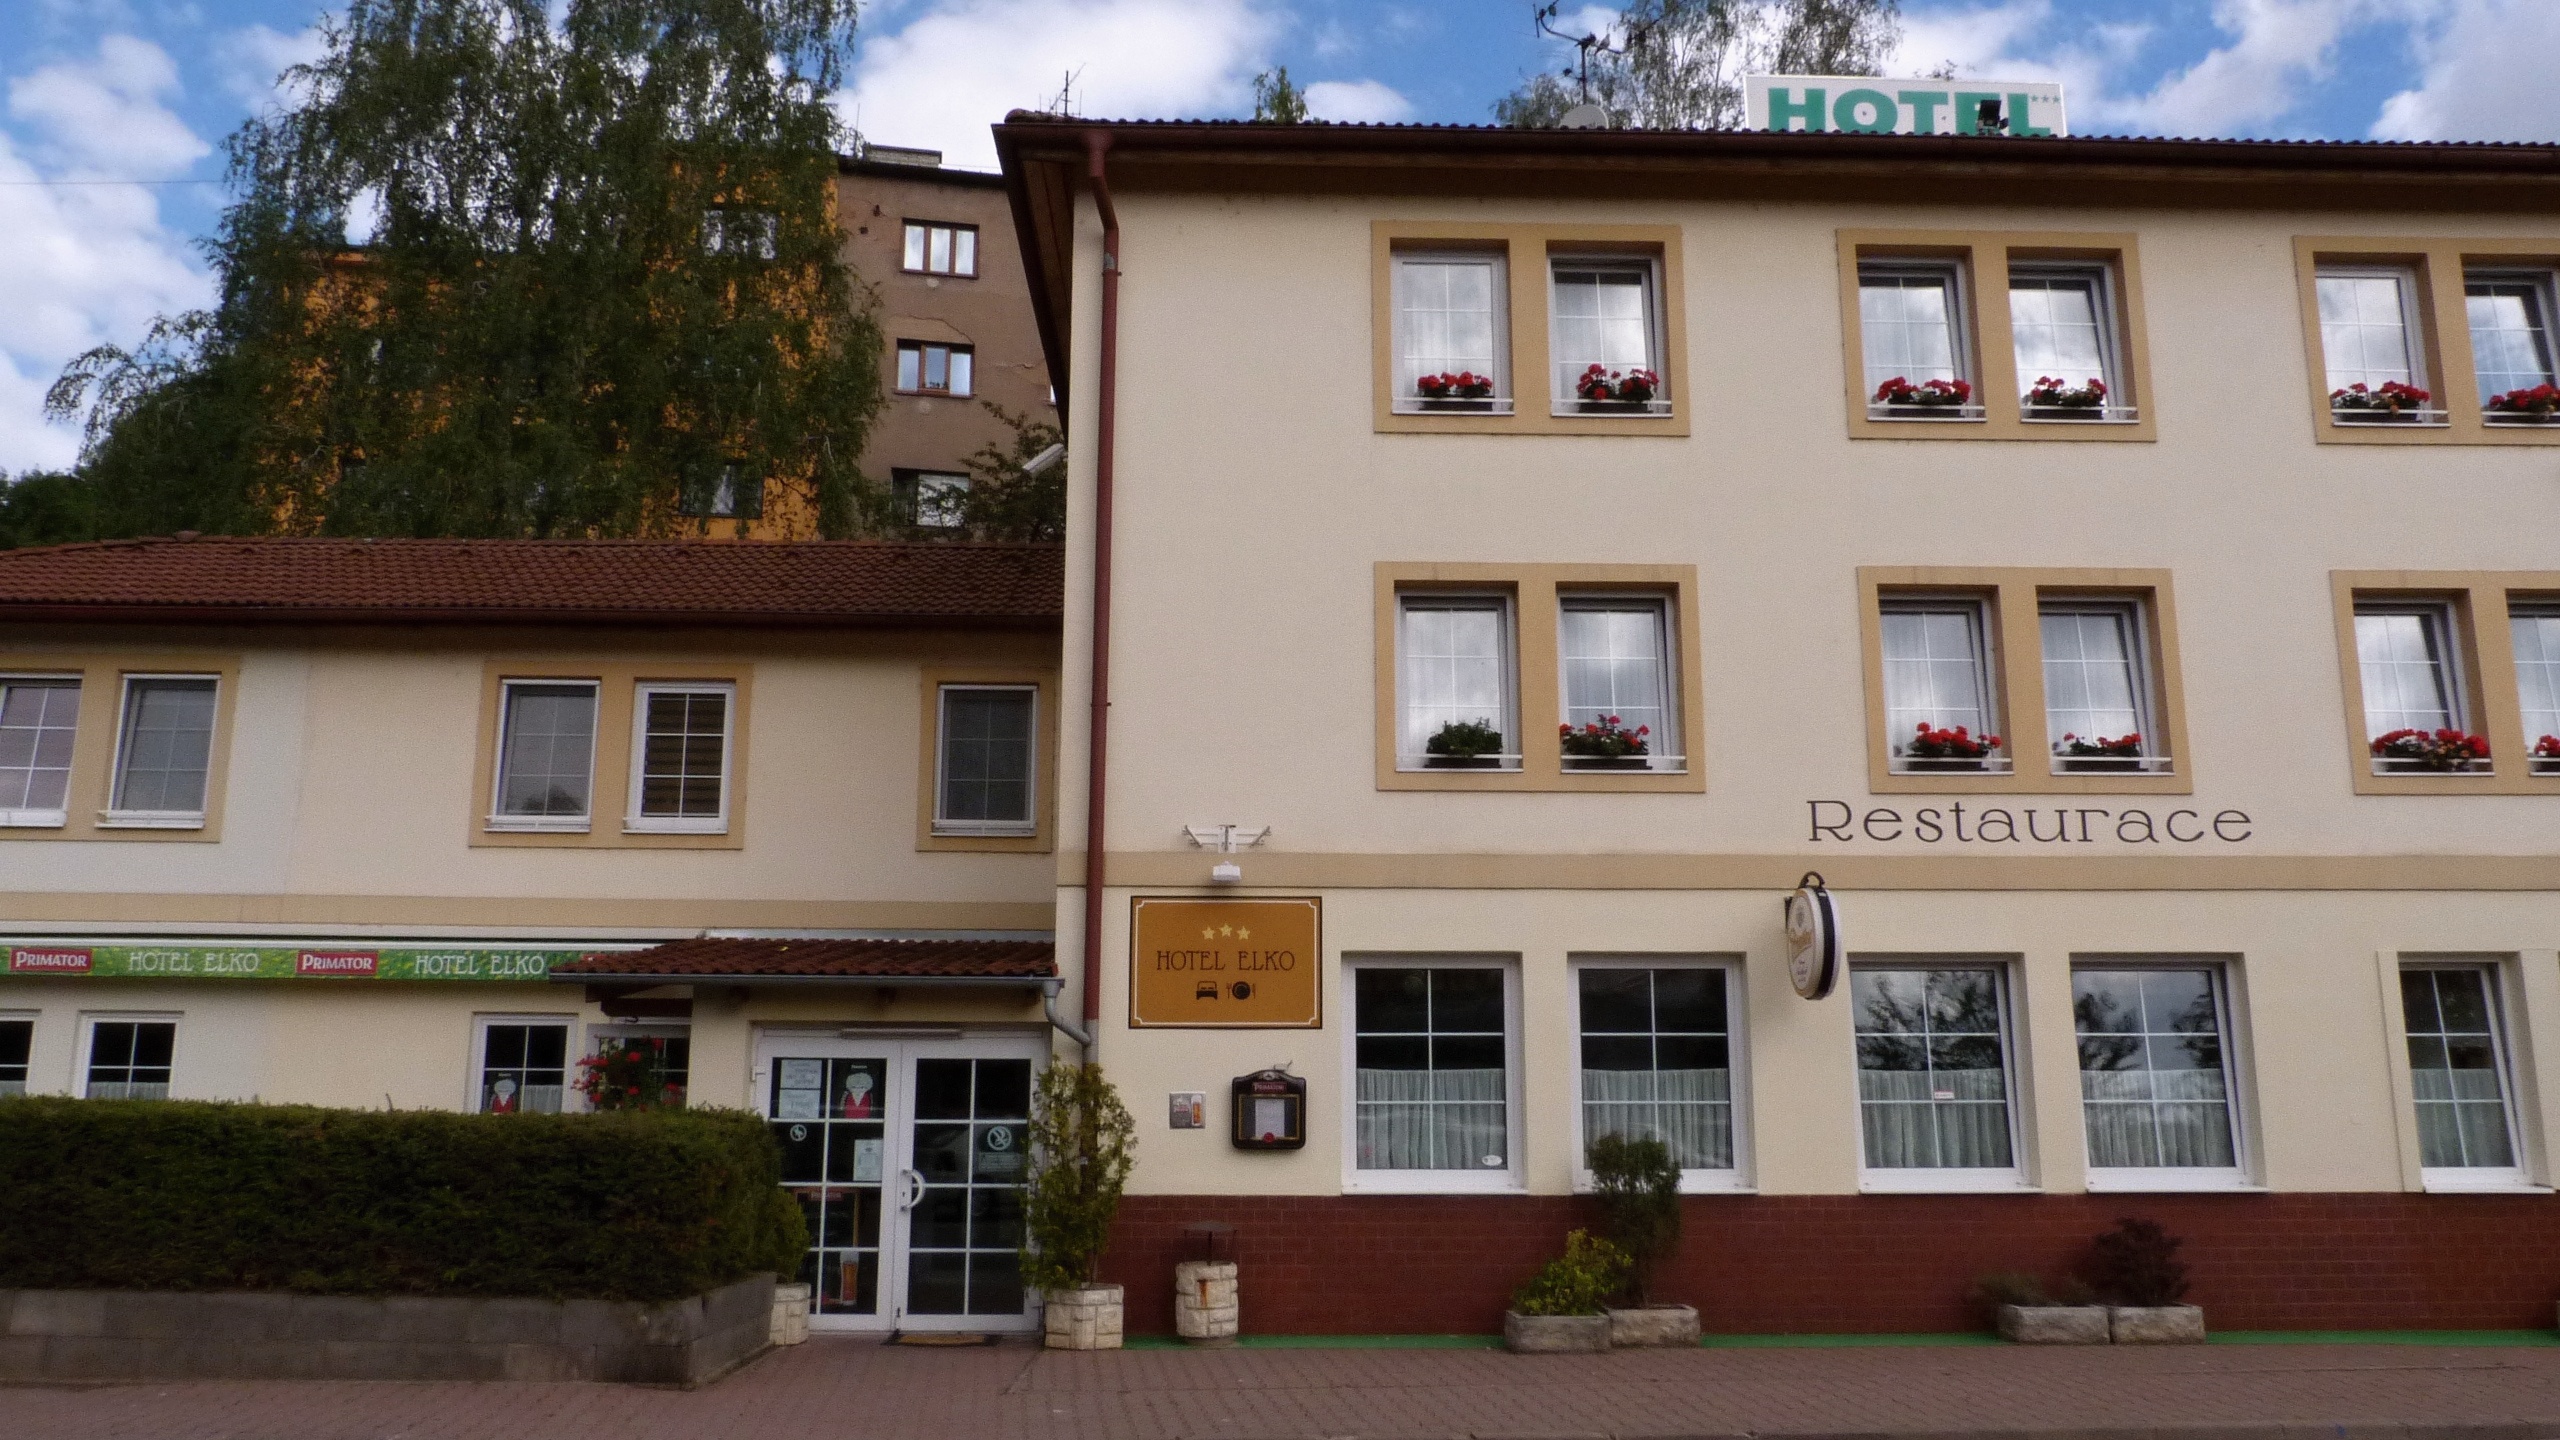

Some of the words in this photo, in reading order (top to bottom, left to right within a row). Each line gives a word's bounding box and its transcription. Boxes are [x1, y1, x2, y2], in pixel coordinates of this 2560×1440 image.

[1768, 87, 2051, 136] HOTEL
[1806, 800, 2253, 843] Restaurace
[15, 951, 88, 967] PRIMATOR
[129, 952, 194, 972] HOTEL
[203, 952, 260, 972] ELKO
[302, 954, 373, 971] PRIMATOR
[415, 954, 480, 975] HOTEL
[490, 954, 545, 975] ELKO
[1156, 950, 1226, 971] HOTEL
[1238, 950, 1296, 971] ELKO
